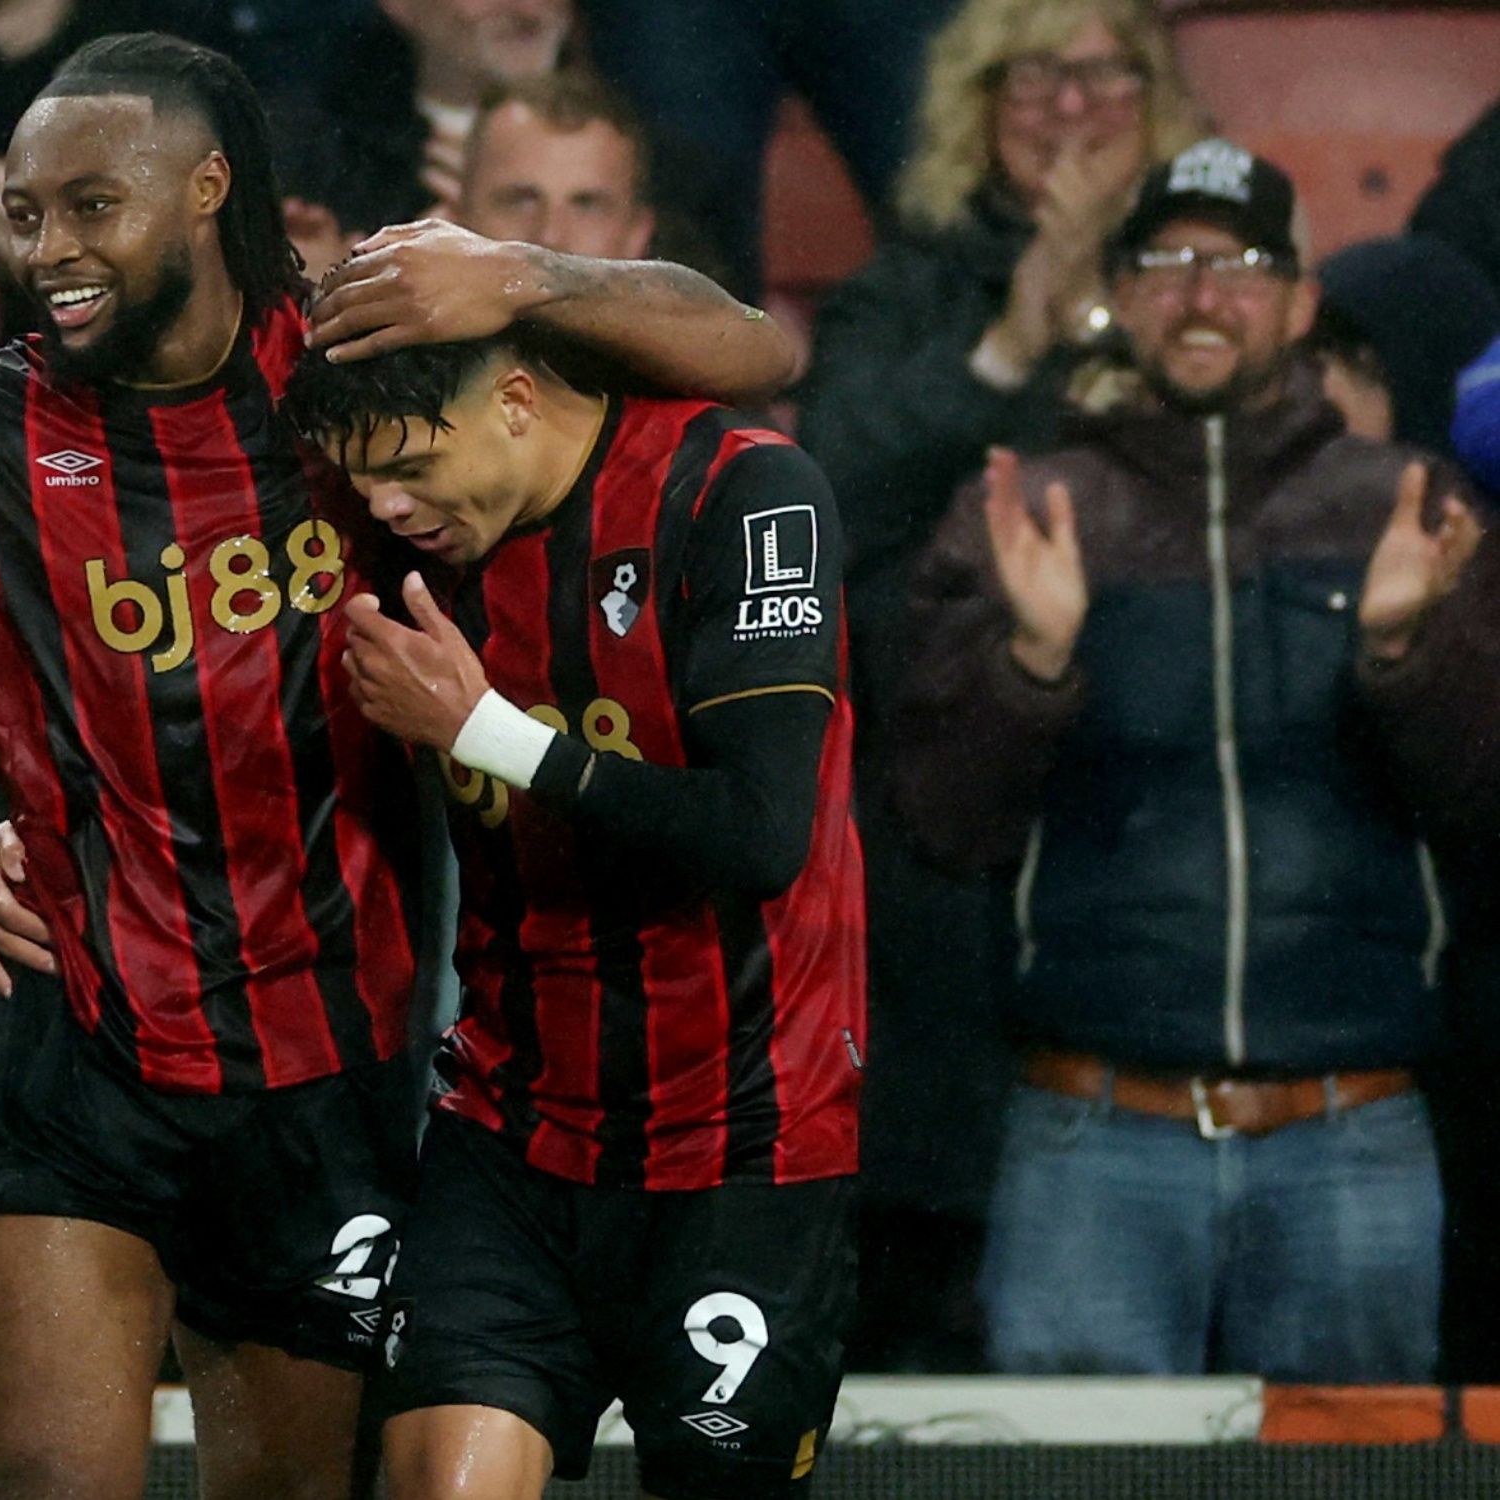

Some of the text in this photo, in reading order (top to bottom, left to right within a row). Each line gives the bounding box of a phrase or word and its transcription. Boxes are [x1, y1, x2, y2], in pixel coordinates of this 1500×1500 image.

[45, 474, 100, 487] umbro
[85, 518, 344, 673] bj88
[734, 595, 823, 631] LEOS
[683, 1291, 769, 1405] 9
